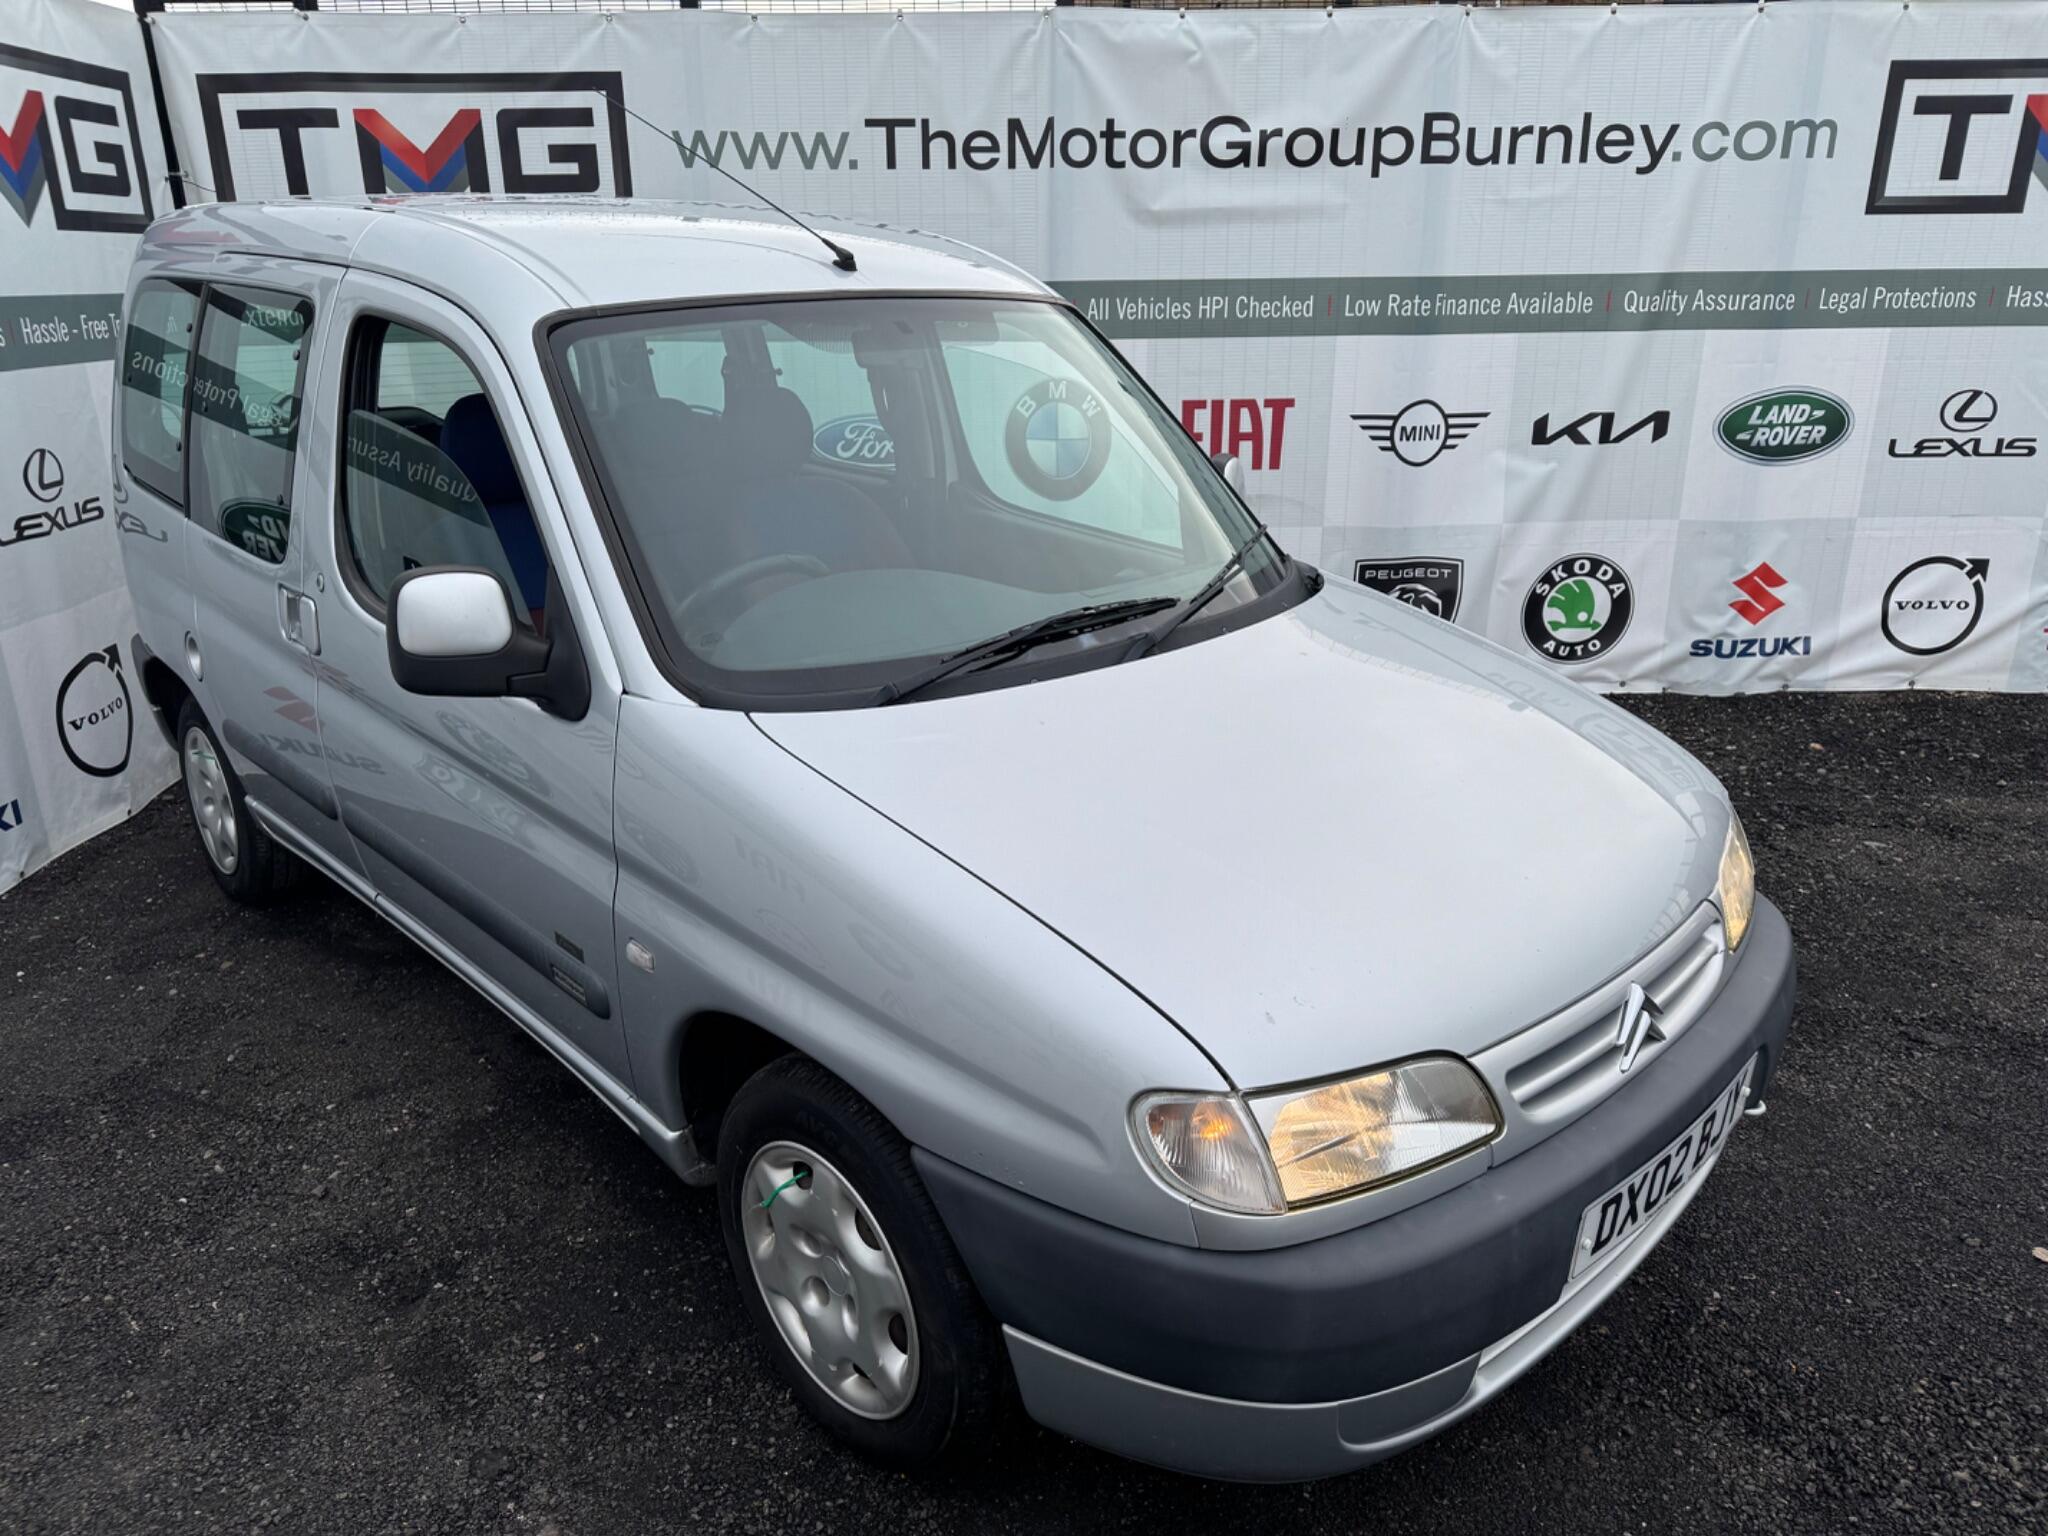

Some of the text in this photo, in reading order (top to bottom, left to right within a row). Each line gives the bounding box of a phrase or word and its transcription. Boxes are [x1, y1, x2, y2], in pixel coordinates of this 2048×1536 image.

[237, 108, 600, 199] TMG
[671, 112, 1838, 177] www.TheMotorGroupBurnley.com
[1087, 294, 1314, 321] All Vehicles HPI Checked
[1344, 291, 1594, 317] Low Rate Finance Available
[1624, 288, 1796, 316] Quality Assurance
[1819, 286, 1977, 314] Legal Protections
[19, 315, 69, 345] Hassle
[80, 314, 110, 340] Free
[1016, 380, 1101, 417] BMW
[1748, 403, 1808, 425] LAND
[836, 422, 894, 459] For
[1181, 398, 1296, 470] FIAT
[1398, 423, 1441, 443] MINI
[1750, 424, 1828, 448] ROVER
[1888, 437, 2038, 458] LEXUS
[1364, 567, 1452, 580] PEUGEOT
[1534, 558, 1627, 599] SKODA
[1895, 599, 1970, 611] VOLVO
[1543, 639, 1601, 657] AUTO
[1689, 635, 1812, 659] SUZUKI
[67, 696, 123, 731] VOLVO
